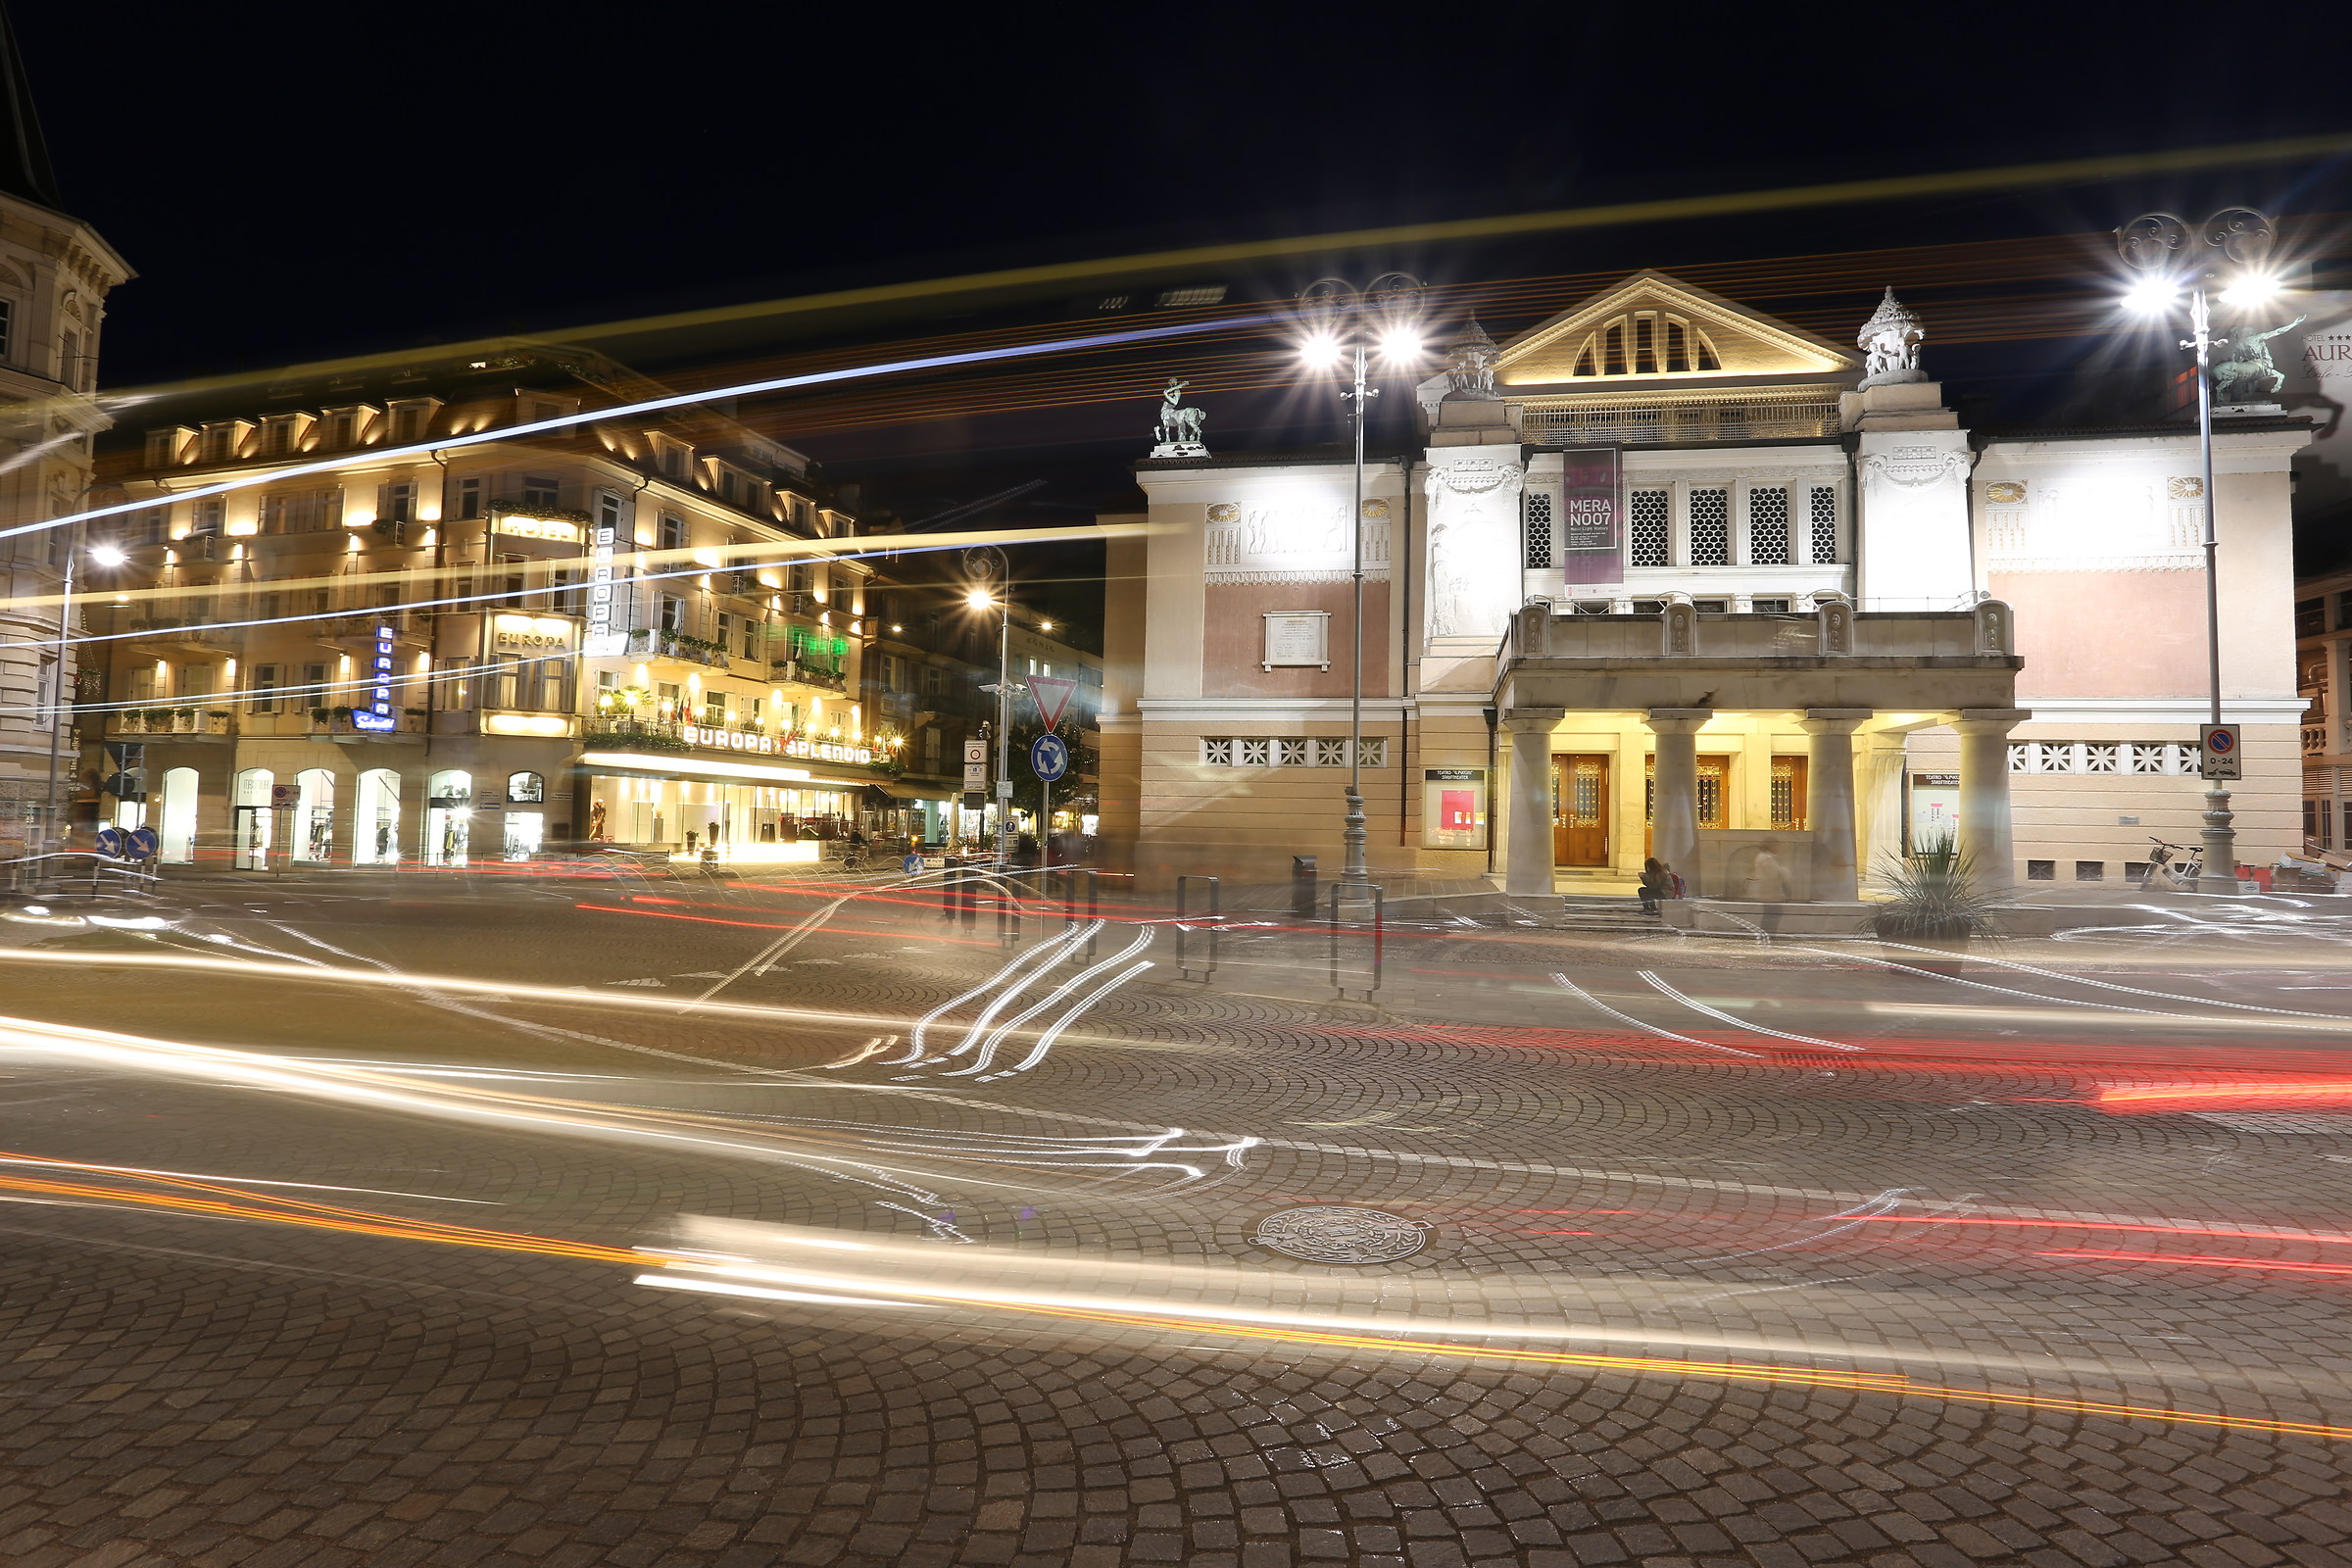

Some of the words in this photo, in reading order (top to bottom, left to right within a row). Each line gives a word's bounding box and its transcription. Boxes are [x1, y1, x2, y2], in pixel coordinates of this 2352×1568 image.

[1570, 499, 1612, 513] MERA
[499, 632, 565, 648] EUROPA
[375, 626, 393, 715] EUROPA
[683, 725, 773, 753] EUROPA
[785, 740, 871, 764] SPLENDID
